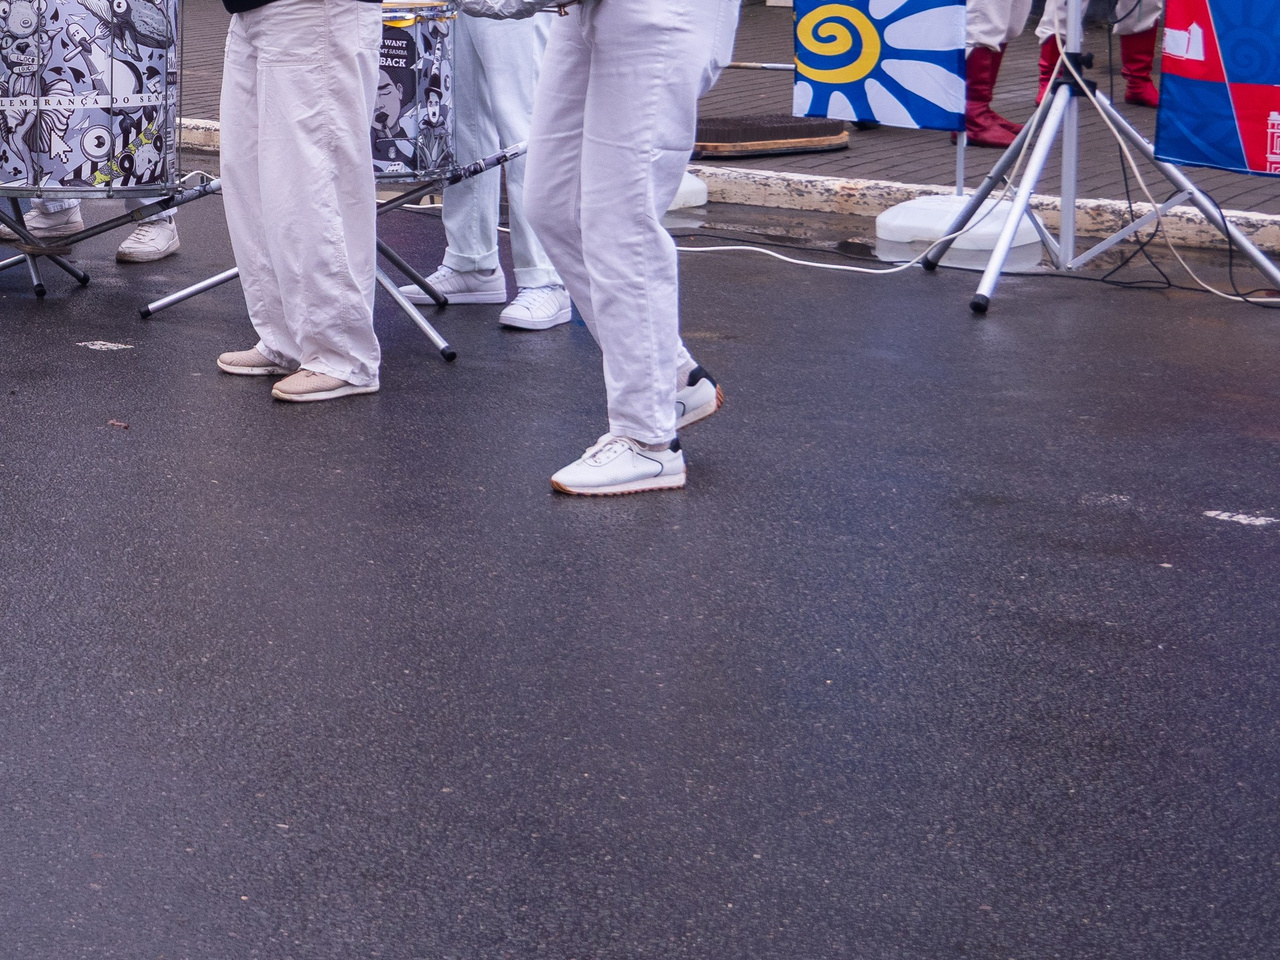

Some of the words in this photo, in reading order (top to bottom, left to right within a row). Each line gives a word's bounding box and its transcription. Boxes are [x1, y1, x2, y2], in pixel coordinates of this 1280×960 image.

[384, 39, 407, 48] WANT
[380, 57, 407, 67] BACK
[0, 97, 99, 108] LEMBRANÇA
